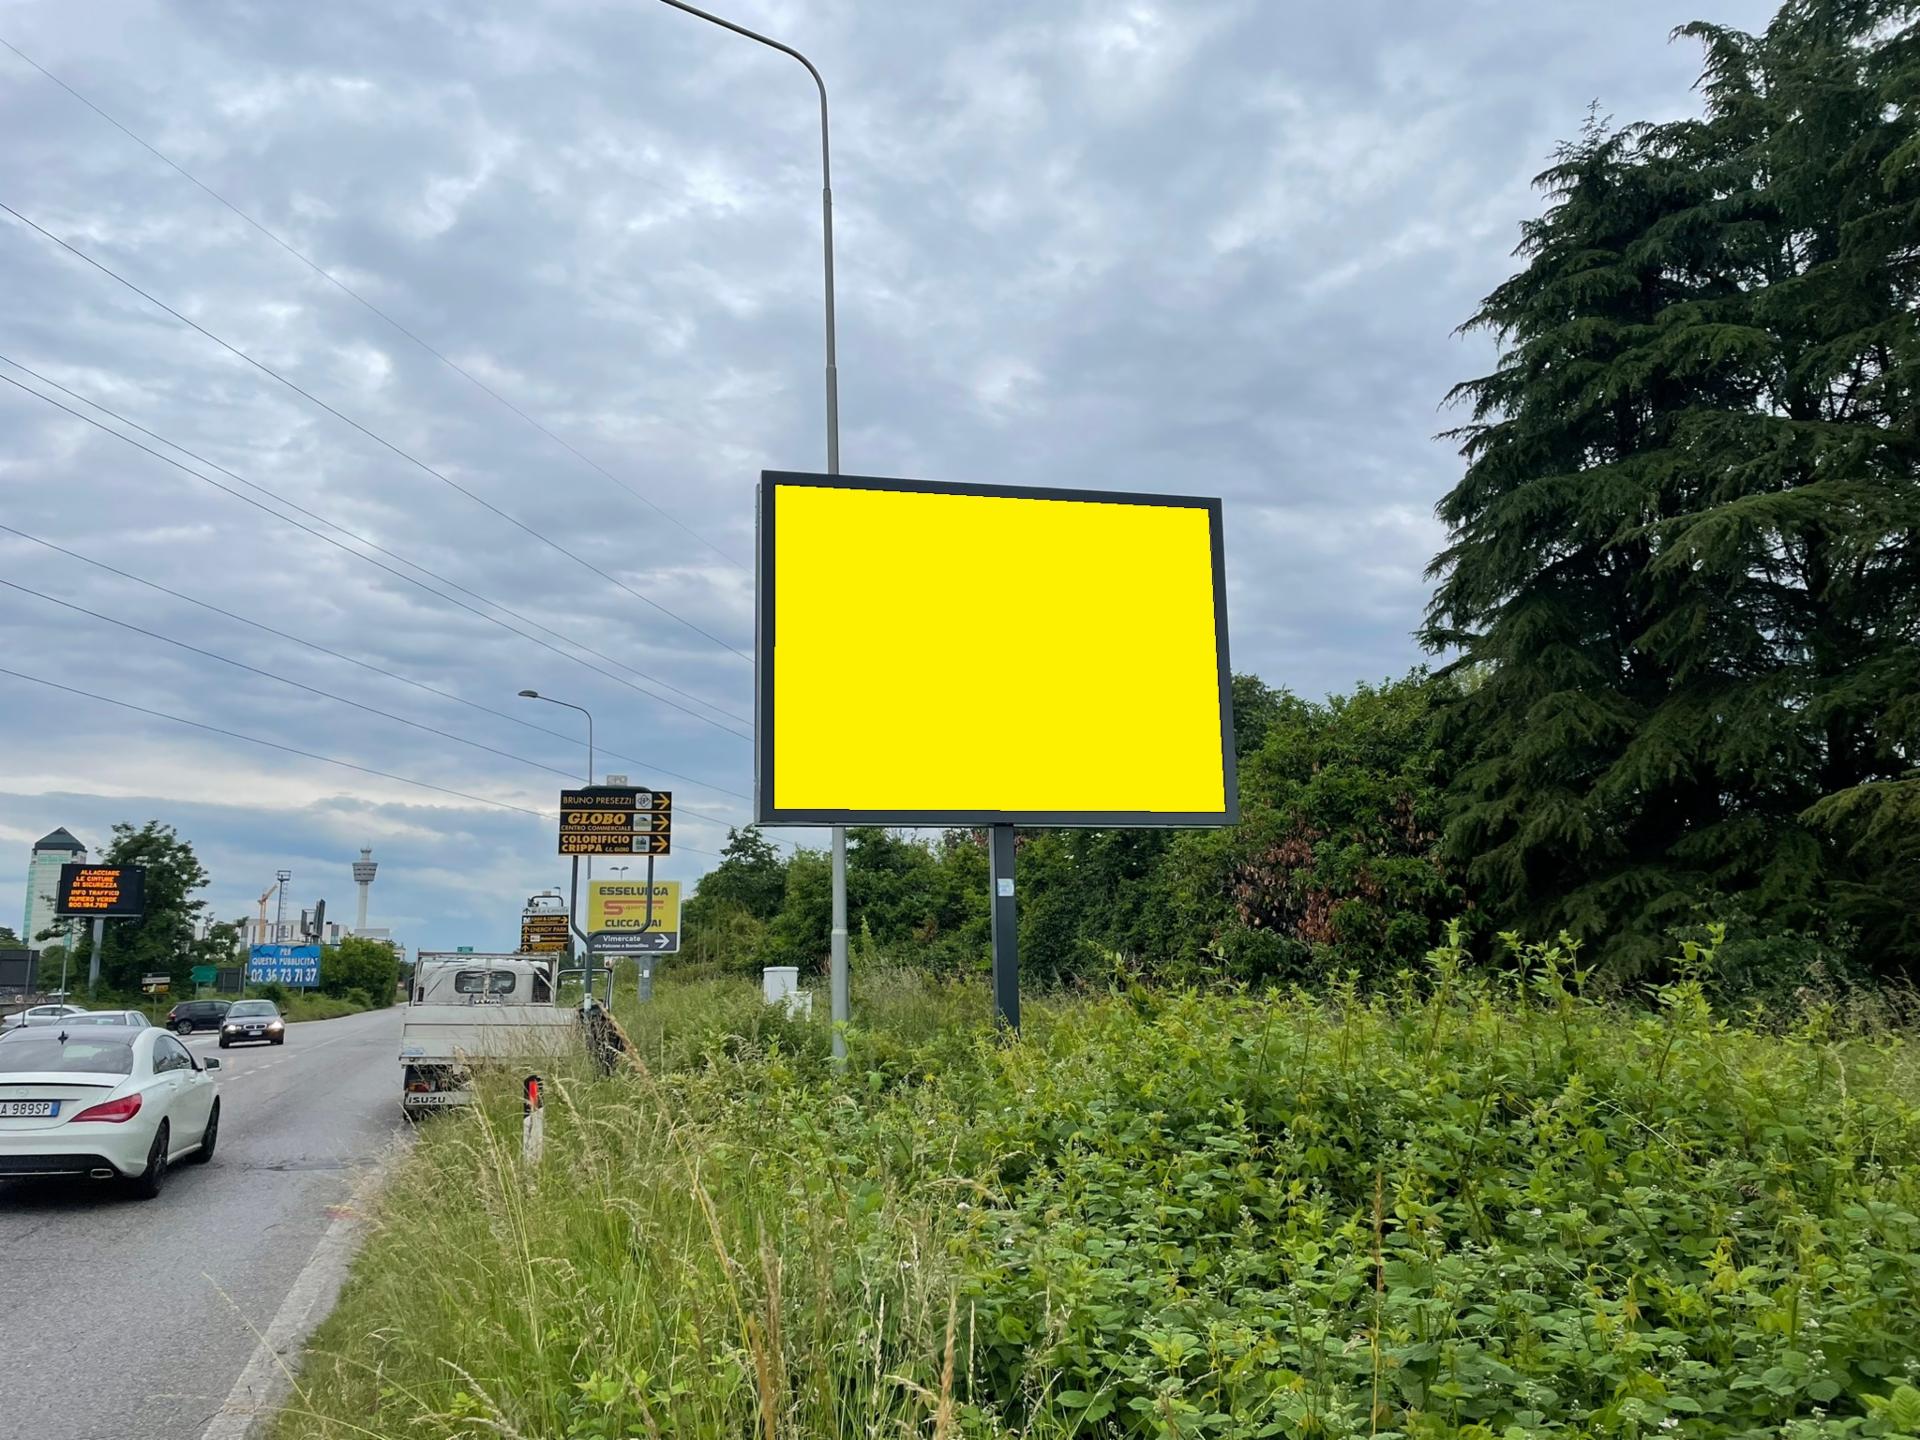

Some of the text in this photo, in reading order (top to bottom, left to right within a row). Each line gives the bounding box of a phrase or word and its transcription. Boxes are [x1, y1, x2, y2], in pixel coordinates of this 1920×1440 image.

[562, 796, 594, 804] BRUNO
[567, 813, 626, 825] GLOBO
[562, 835, 630, 844] COLORIFICIO
[561, 844, 603, 852] CRIPPA
[599, 886, 669, 896] ESSELUGA
[251, 957, 277, 966] QUESTA
[251, 968, 263, 983] 02
[280, 968, 292, 982] 73
[294, 968, 303, 982] 71
[305, 968, 317, 982] 37
[408, 1096, 446, 1104] ISUZU
[12, 1103, 50, 1115] 989SP
